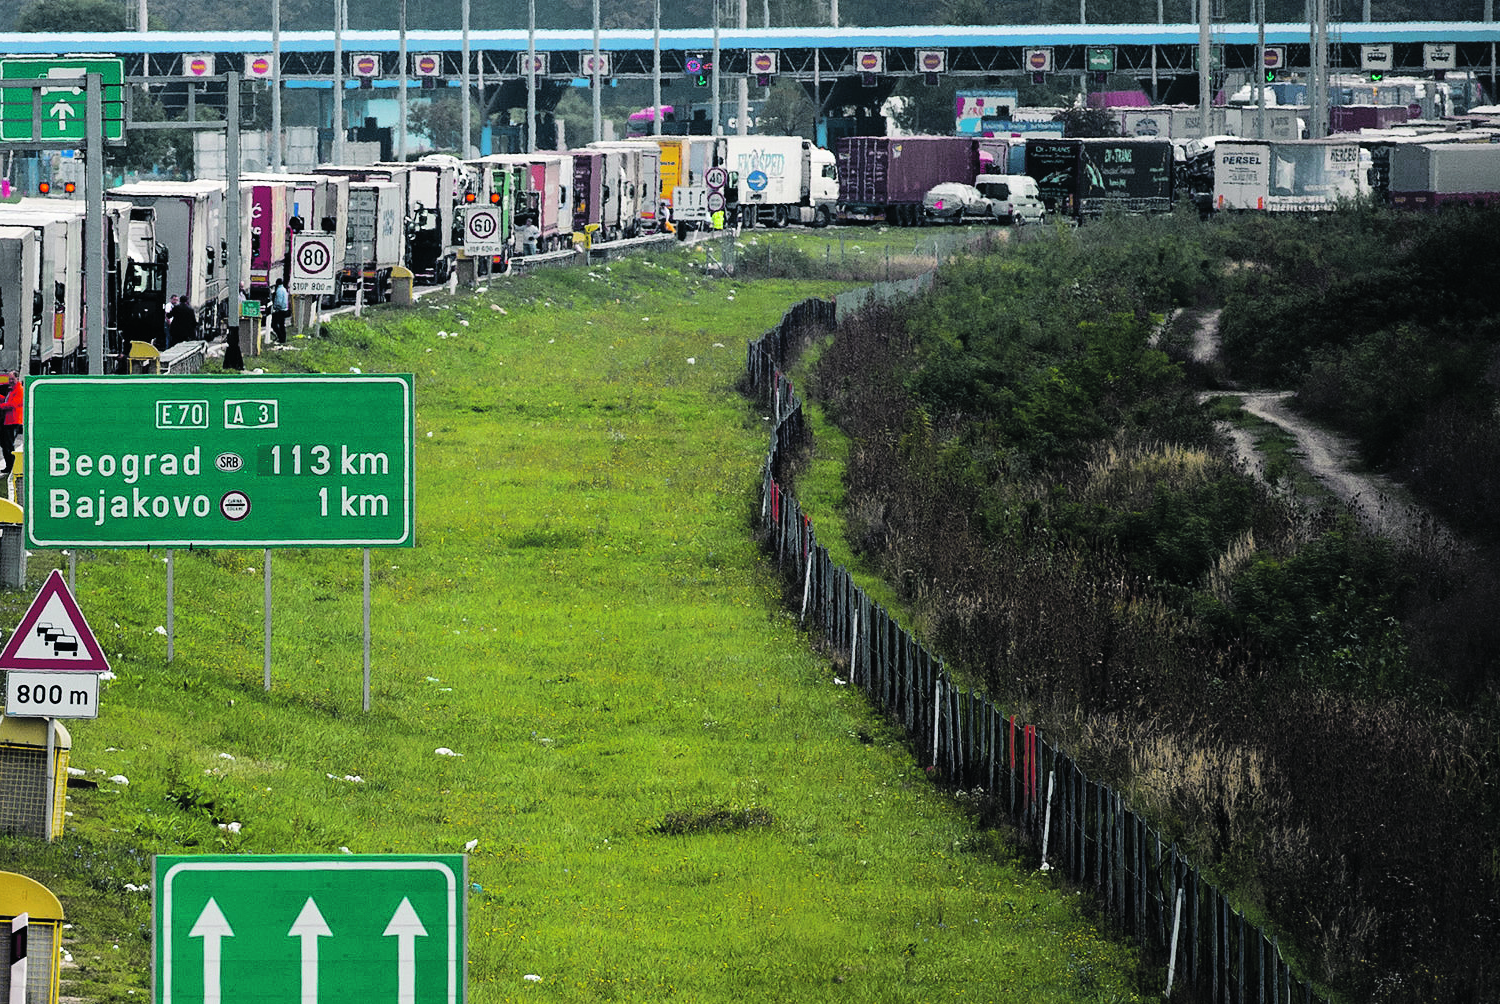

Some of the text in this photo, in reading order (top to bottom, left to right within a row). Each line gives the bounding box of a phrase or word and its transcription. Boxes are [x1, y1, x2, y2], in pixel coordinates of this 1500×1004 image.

[1222, 156, 1262, 165] PERSEL
[474, 218, 492, 233] 60
[303, 249, 324, 266] 80
[292, 282, 309, 291] STOP
[162, 405, 203, 425] E 70
[233, 406, 269, 424] A 3
[48, 445, 389, 483] Beograd SRB 113 km
[49, 487, 389, 526] Bajakovo 1 km
[17, 685, 87, 704] 800 m
